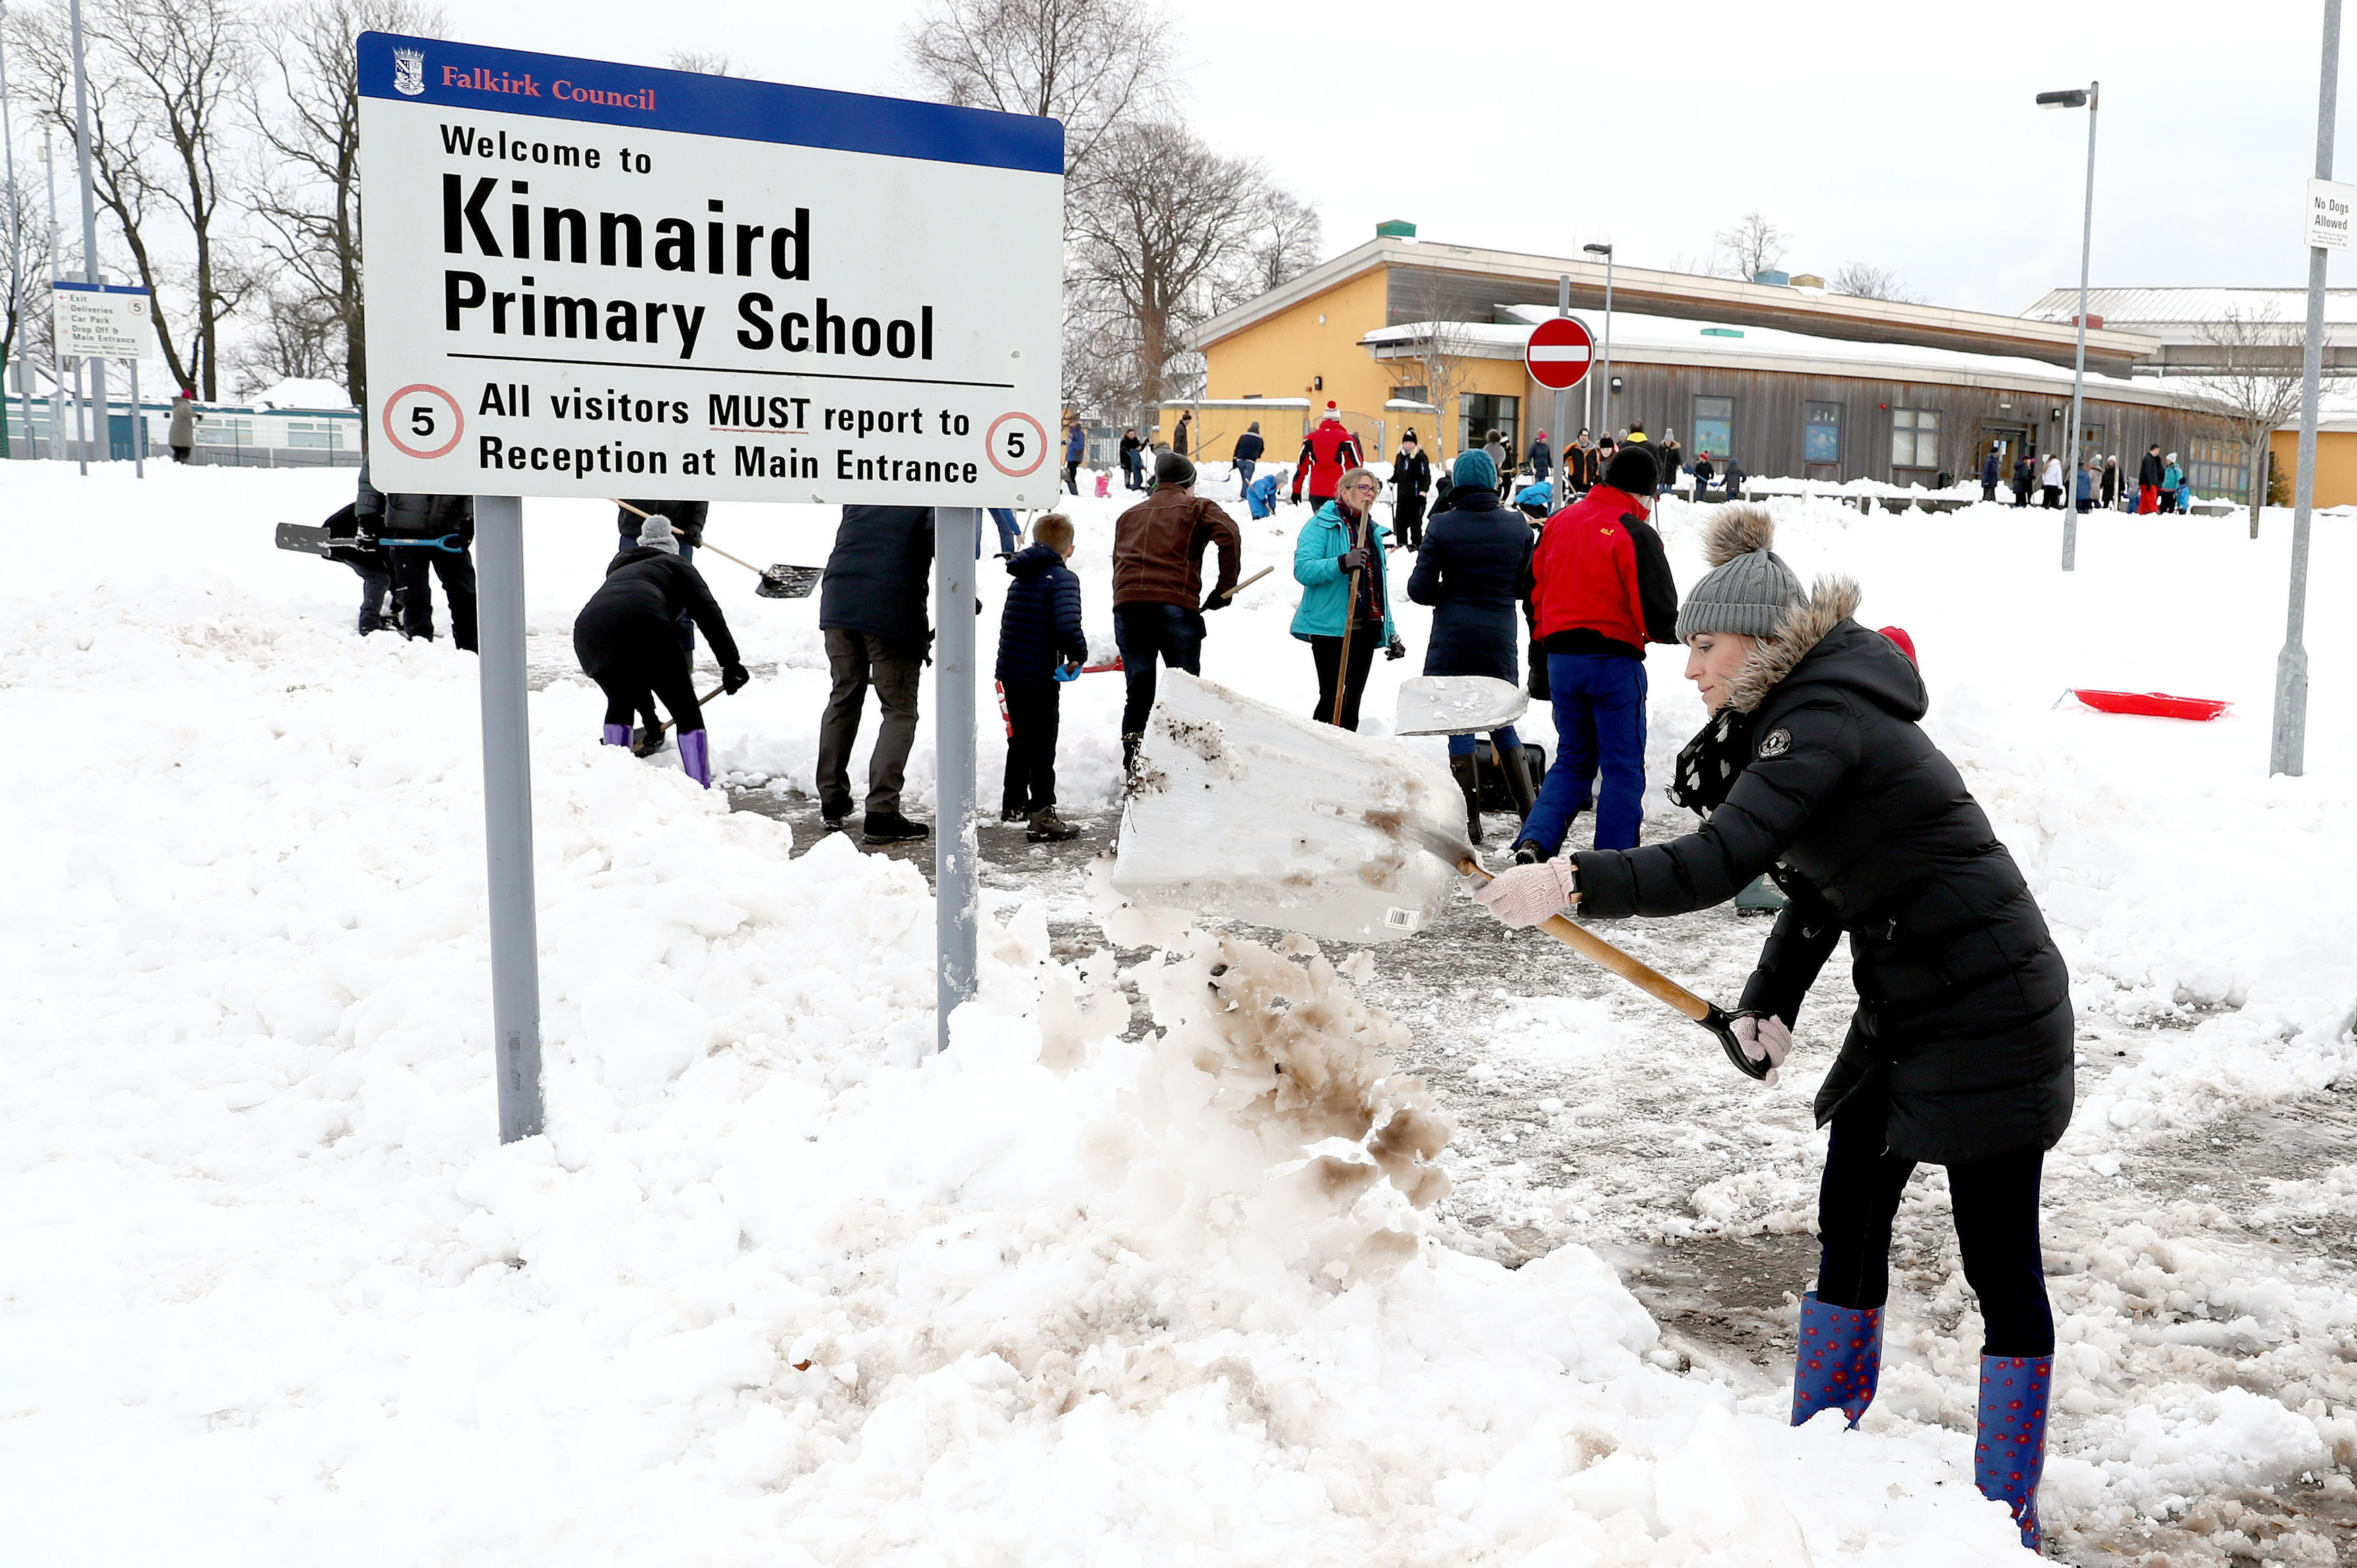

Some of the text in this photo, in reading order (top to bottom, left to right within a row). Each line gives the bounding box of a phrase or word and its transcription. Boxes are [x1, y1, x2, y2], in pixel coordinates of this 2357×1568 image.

[442, 65, 656, 110] Falkirk Council
[440, 124, 652, 174] Welcome to
[2315, 197, 2349, 215] No Dogs
[442, 173, 810, 281] Kinnaird
[2315, 214, 2348, 230] Allowed
[70, 294, 87, 302] Exit
[133, 303, 141, 312] 5
[71, 305, 113, 314] Deliveries
[90, 316, 110, 324] Park
[444, 269, 933, 360] Primary School
[72, 325, 92, 334] Drop
[96, 326, 108, 334] Off
[73, 333, 135, 344] Main Entrance
[411, 407, 435, 436] 5
[479, 382, 970, 439] All visitors MUST report to
[1007, 432, 1025, 458] 5
[479, 435, 978, 483] Reception at Main Entrance
